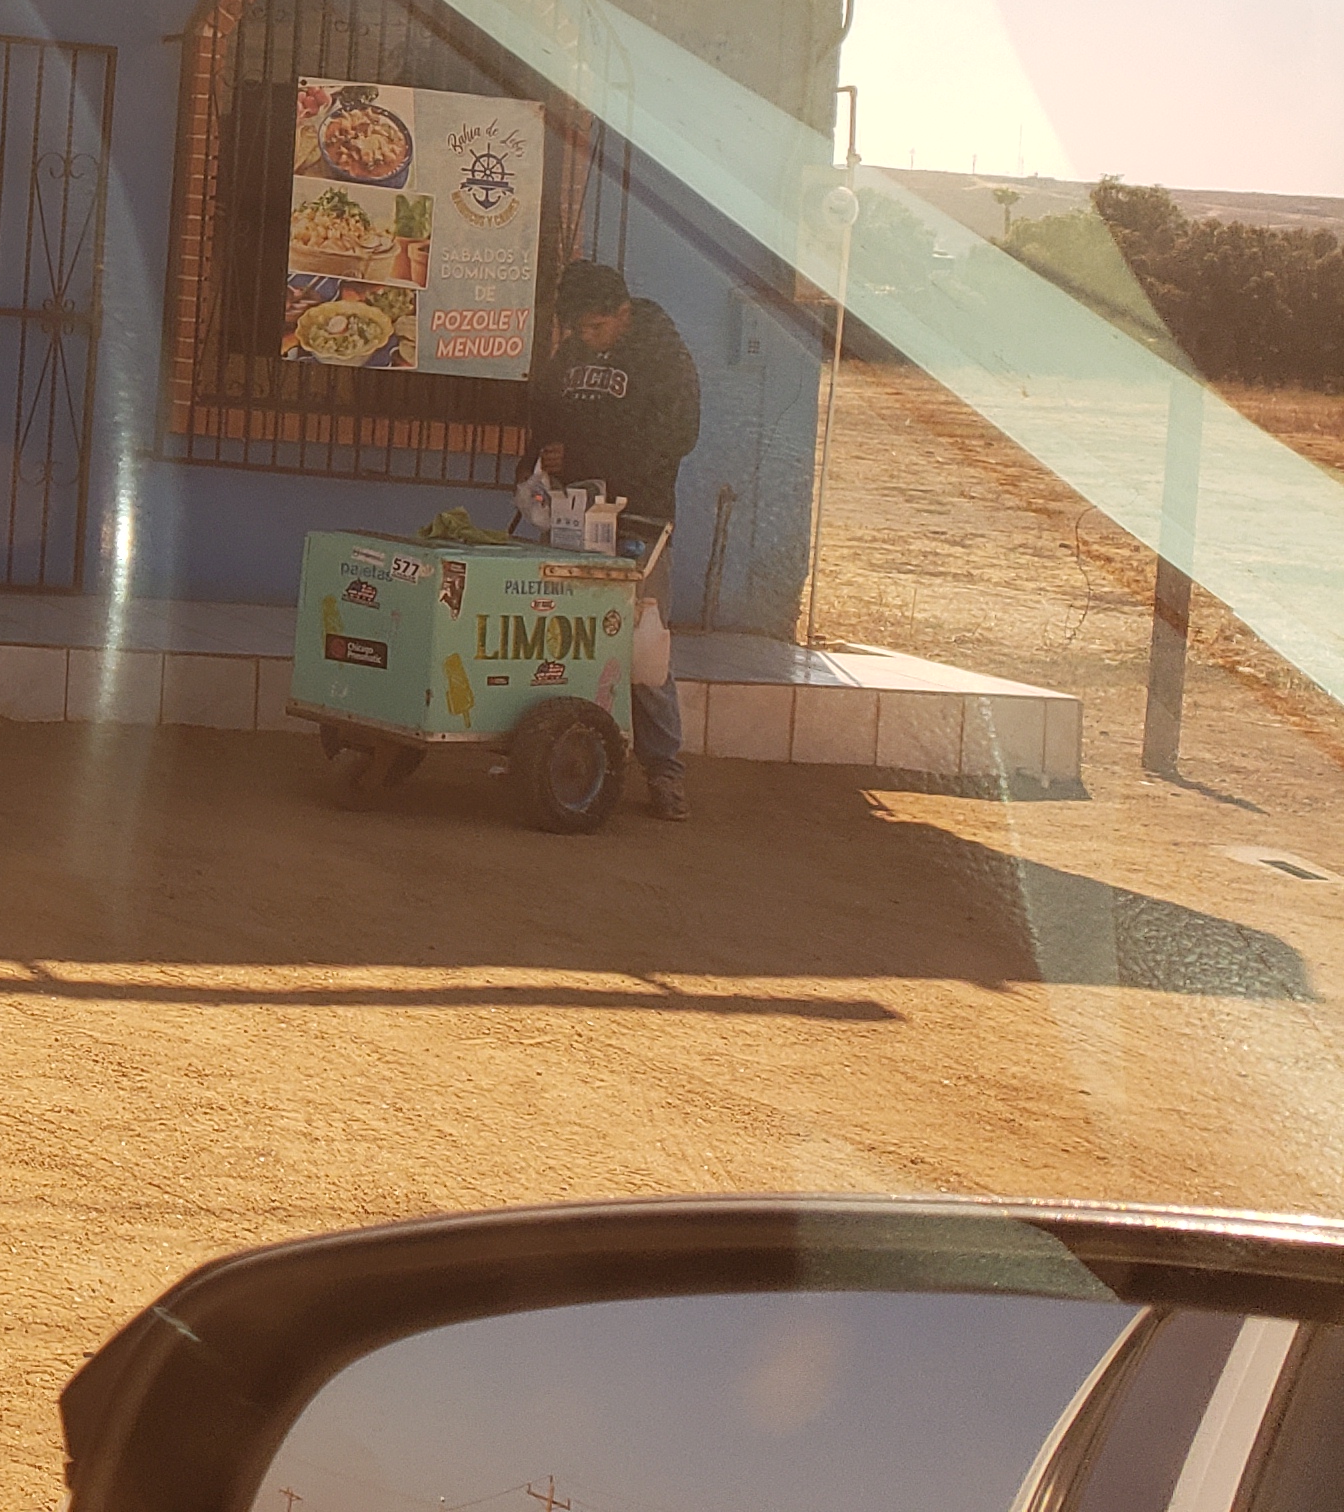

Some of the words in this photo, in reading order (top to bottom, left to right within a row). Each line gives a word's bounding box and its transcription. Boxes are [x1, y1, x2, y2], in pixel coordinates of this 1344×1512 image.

[440, 264, 532, 281] DOMINGOS
[474, 285, 495, 302] DE
[432, 309, 510, 331] POZOLE
[515, 309, 530, 330] Y
[436, 337, 523, 358] MENUDO
[340, 562, 393, 582] paetas
[392, 557, 420, 576] 577
[474, 614, 596, 660] LIMON
